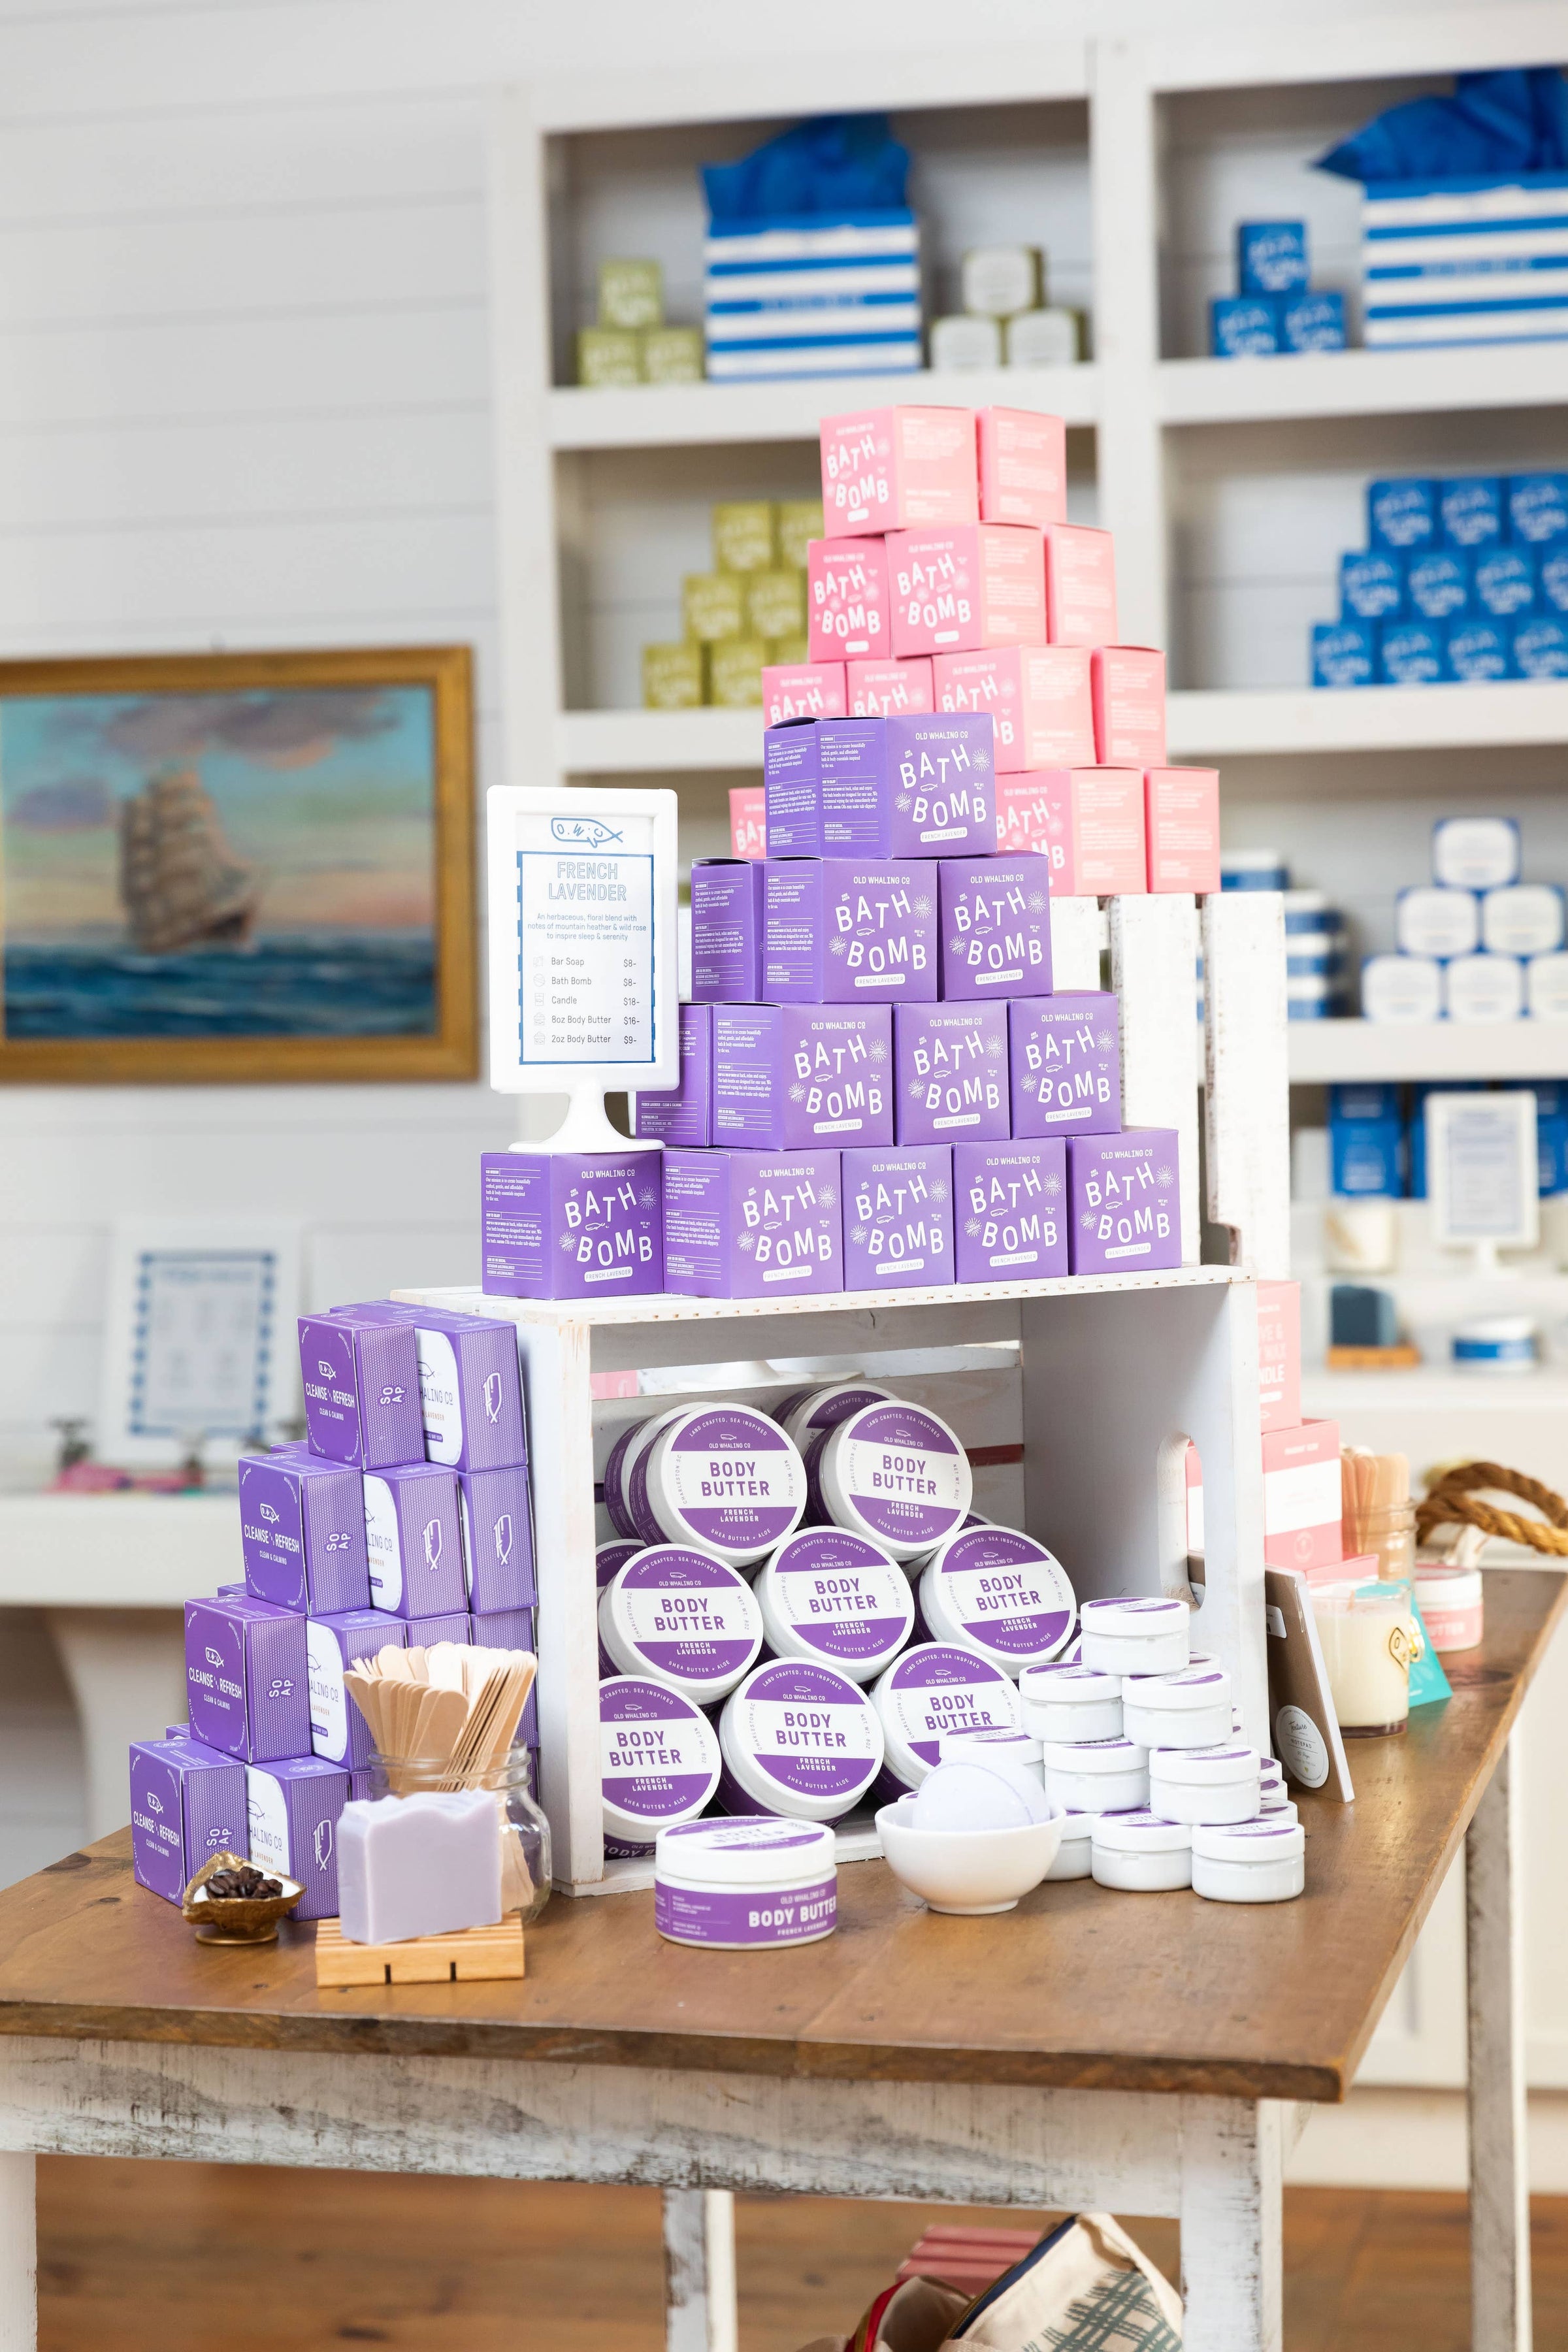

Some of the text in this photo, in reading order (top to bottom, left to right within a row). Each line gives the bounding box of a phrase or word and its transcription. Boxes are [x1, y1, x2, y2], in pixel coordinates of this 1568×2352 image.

[826, 434, 875, 479] BATH
[835, 474, 889, 509] BOMB
[814, 564, 866, 604] BATH
[897, 553, 956, 596] BATH
[907, 593, 972, 629] BOMB
[821, 604, 881, 638] BOMB
[941, 674, 999, 713] BATH
[770, 687, 825, 724] BATH
[929, 731, 958, 740] WHALING
[900, 744, 970, 789] BATH
[913, 790, 987, 826] BOMB
[557, 862, 617, 879] FRENCH
[985, 875, 1014, 883] WHALING
[548, 883, 627, 901] LAVENDER
[547, 913, 585, 921] herbaceous,
[836, 889, 911, 932] BATH
[955, 887, 1026, 932] BATH
[555, 932, 577, 941] inspire
[578, 932, 595, 941] sleep
[847, 936, 926, 972] BOMB
[967, 933, 1043, 969] BOMB
[566, 957, 585, 967] Soap
[571, 977, 592, 985] Bomb
[551, 1015, 565, 1024] 8oz
[567, 1015, 585, 1025] Body
[1041, 1014, 1053, 1022] OLD
[1054, 1013, 1084, 1022] WHALING
[567, 1035, 585, 1045] Body
[1026, 1025, 1095, 1070] BATH
[794, 1034, 867, 1079] BATH
[913, 1030, 984, 1075] BATH
[926, 1077, 1000, 1113] BOMB
[1037, 1070, 1111, 1107] BOMB
[806, 1081, 883, 1118] BOMB
[836, 1121, 860, 1130] LAVENDER
[1102, 1151, 1113, 1160] OLD
[1115, 1150, 1144, 1158] WHALING
[595, 1169, 625, 1178] WHALING
[970, 1169, 1042, 1214] BATH
[1086, 1162, 1154, 1207] BATH
[564, 1182, 637, 1228] BATH
[743, 1181, 816, 1227] BATH
[855, 1175, 928, 1221] BATH
[982, 1215, 1058, 1251] BOMB
[1098, 1207, 1170, 1243] BOMB
[577, 1228, 653, 1266] BOMB
[755, 1226, 832, 1266] BOMB
[868, 1221, 943, 1258] BOMB
[585, 1269, 632, 1280] FRENCH LAVENDER
[306, 1382, 355, 1408] CLEANSE REFRESH
[689, 1426, 702, 1437] LAND
[742, 1420, 768, 1437] INSPIRED
[710, 1462, 755, 1477] BODY
[883, 1455, 926, 1475] BODY
[701, 1480, 770, 1496] BUTTER
[873, 1472, 937, 1495] BUTTER
[887, 1508, 924, 1518] LAVENDER
[891, 1502, 919, 1511] FRENCH
[244, 1524, 299, 1554] CLEANSE REFRESH
[711, 1528, 725, 1539] SHEA
[758, 1527, 772, 1538] ALOE
[259, 1550, 270, 1560] CLEAN
[814, 1578, 859, 1595] BODY
[979, 1574, 1022, 1593] BODY
[661, 1598, 708, 1613] BODY
[808, 1595, 878, 1613] BUTTER
[975, 1590, 1042, 1611] BUTTER
[654, 1616, 725, 1631] BUTTER
[1001, 1622, 1037, 1633] LAVENDER
[1002, 1617, 1031, 1626] FRENCH
[832, 1627, 871, 1636] LAVENDER
[189, 1667, 242, 1700] CLEANSE REFRESH
[203, 1693, 214, 1705] CLEAN
[930, 1694, 974, 1711] BODY
[784, 1712, 831, 1728] BODY
[924, 1711, 993, 1730] BUTTER
[616, 1731, 664, 1748] BODY
[776, 1730, 847, 1747] BUTTER
[1290, 1739, 1312, 1749] NOTEPAD
[609, 1749, 682, 1767] BUTTER
[632, 1783, 674, 1791] LAVENDER
[133, 1810, 180, 1848] CLEANSE REFRESH
[749, 1895, 837, 1928] BODY BUTTER
